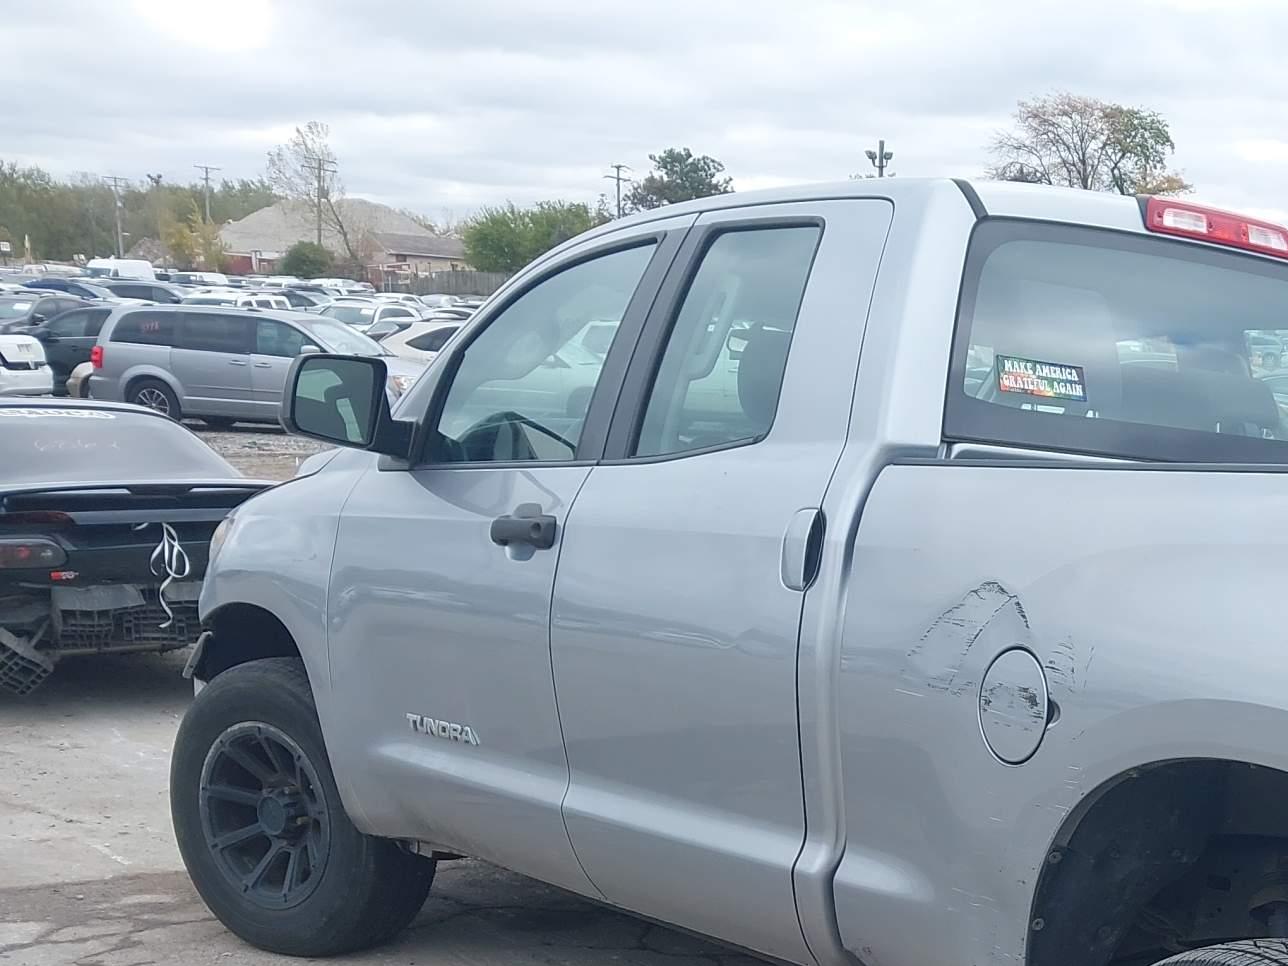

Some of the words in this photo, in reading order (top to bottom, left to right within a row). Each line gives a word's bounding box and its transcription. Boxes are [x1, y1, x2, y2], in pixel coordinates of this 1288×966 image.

[1004, 360, 1033, 374] MAKE
[1036, 364, 1079, 381] AMERICA
[1003, 374, 1050, 391] GRATEFUL
[1053, 381, 1083, 396] AGAIN
[406, 712, 480, 746] TUNDRA
